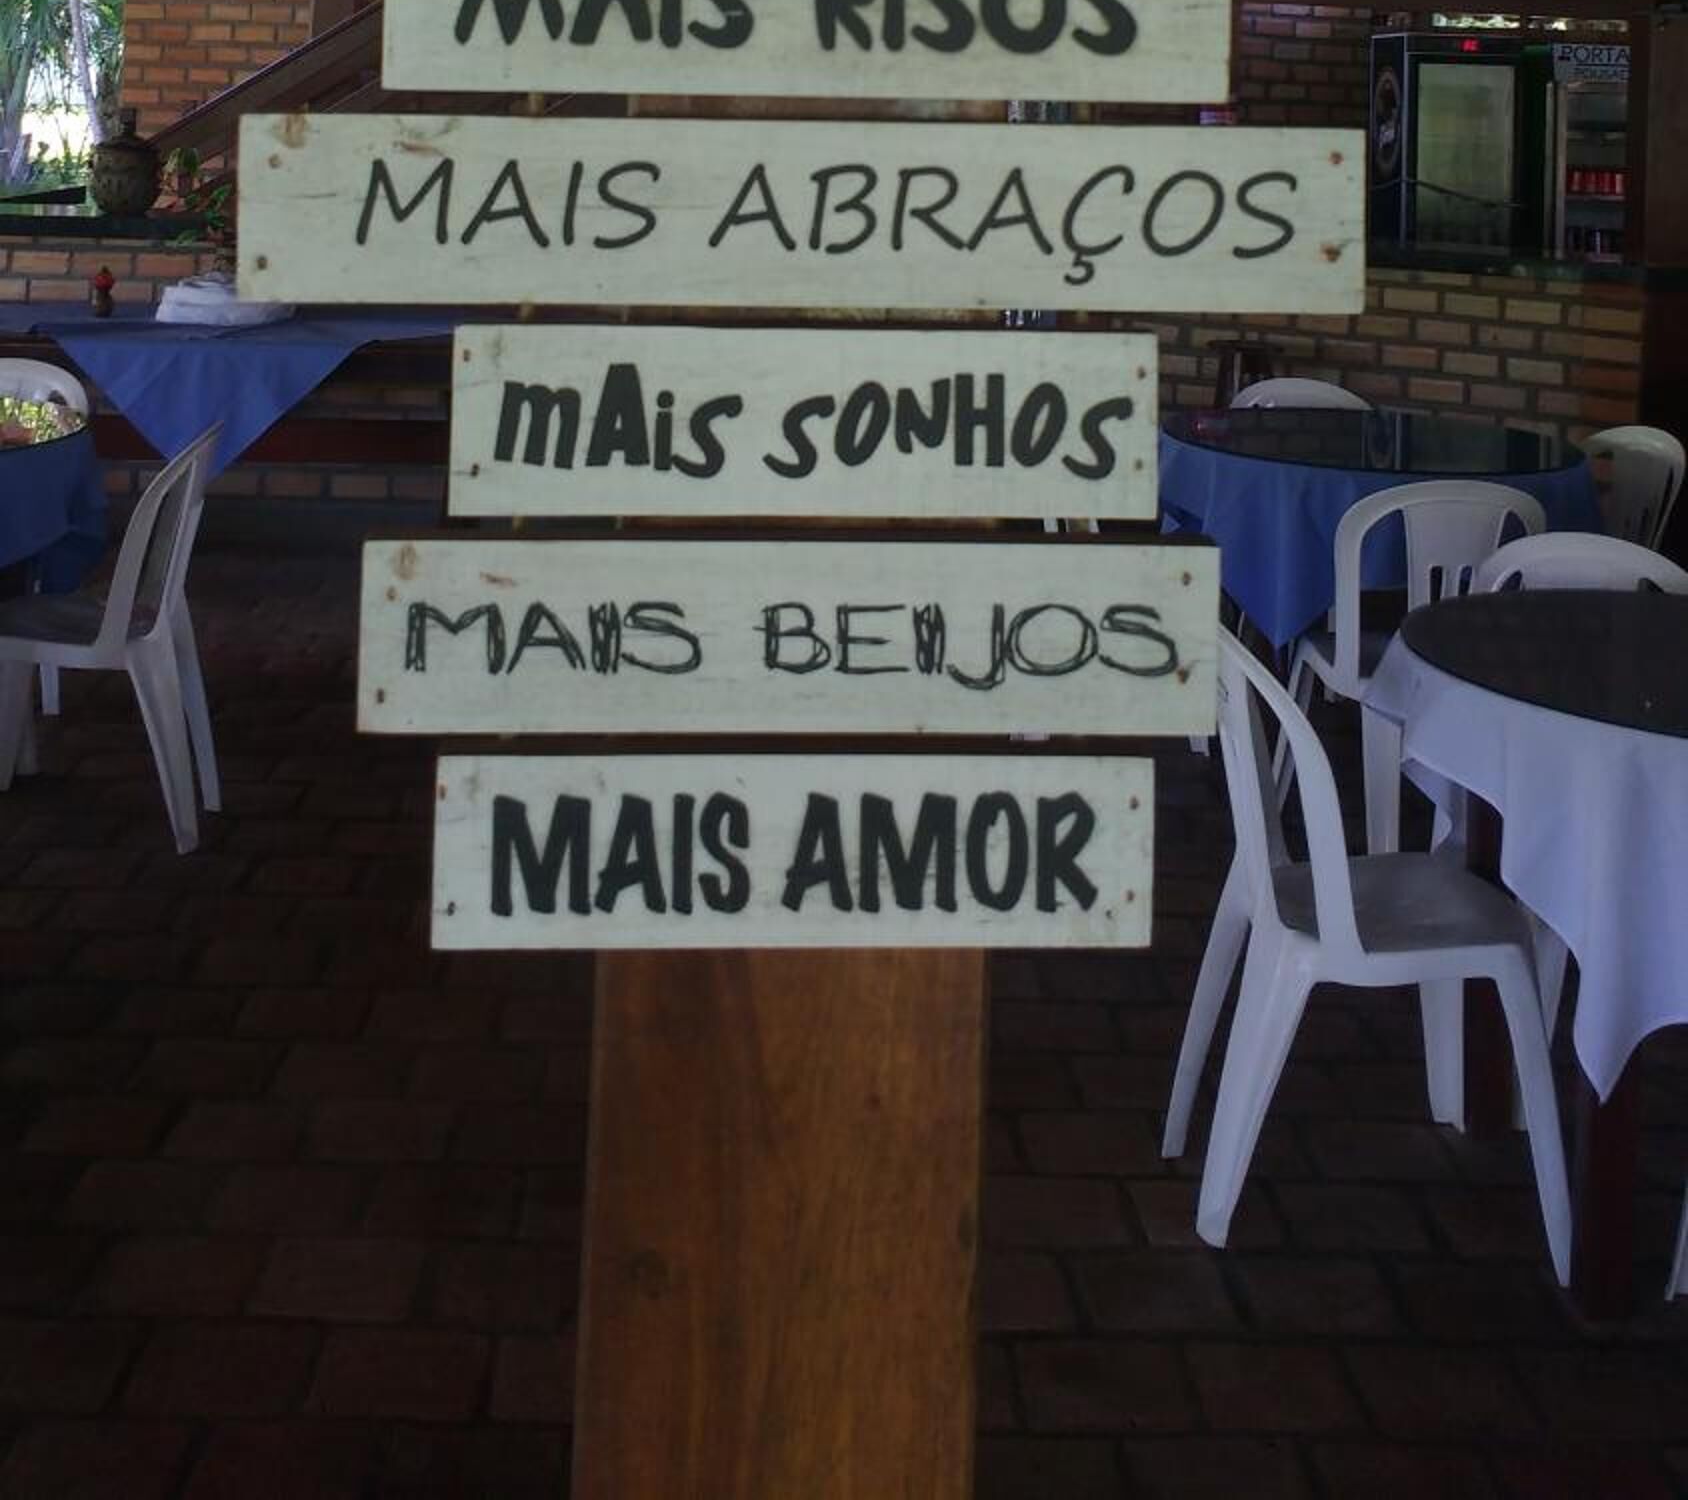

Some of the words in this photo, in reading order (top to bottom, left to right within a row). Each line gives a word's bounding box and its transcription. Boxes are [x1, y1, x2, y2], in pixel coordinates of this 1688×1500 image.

[355, 157, 661, 250] MAIS
[708, 163, 1298, 286] ABRAÇOS
[404, 601, 703, 676] MAIS
[754, 601, 1181, 691] BEIJOS
[490, 792, 751, 918] MAIS
[780, 791, 1099, 914] AMOR
